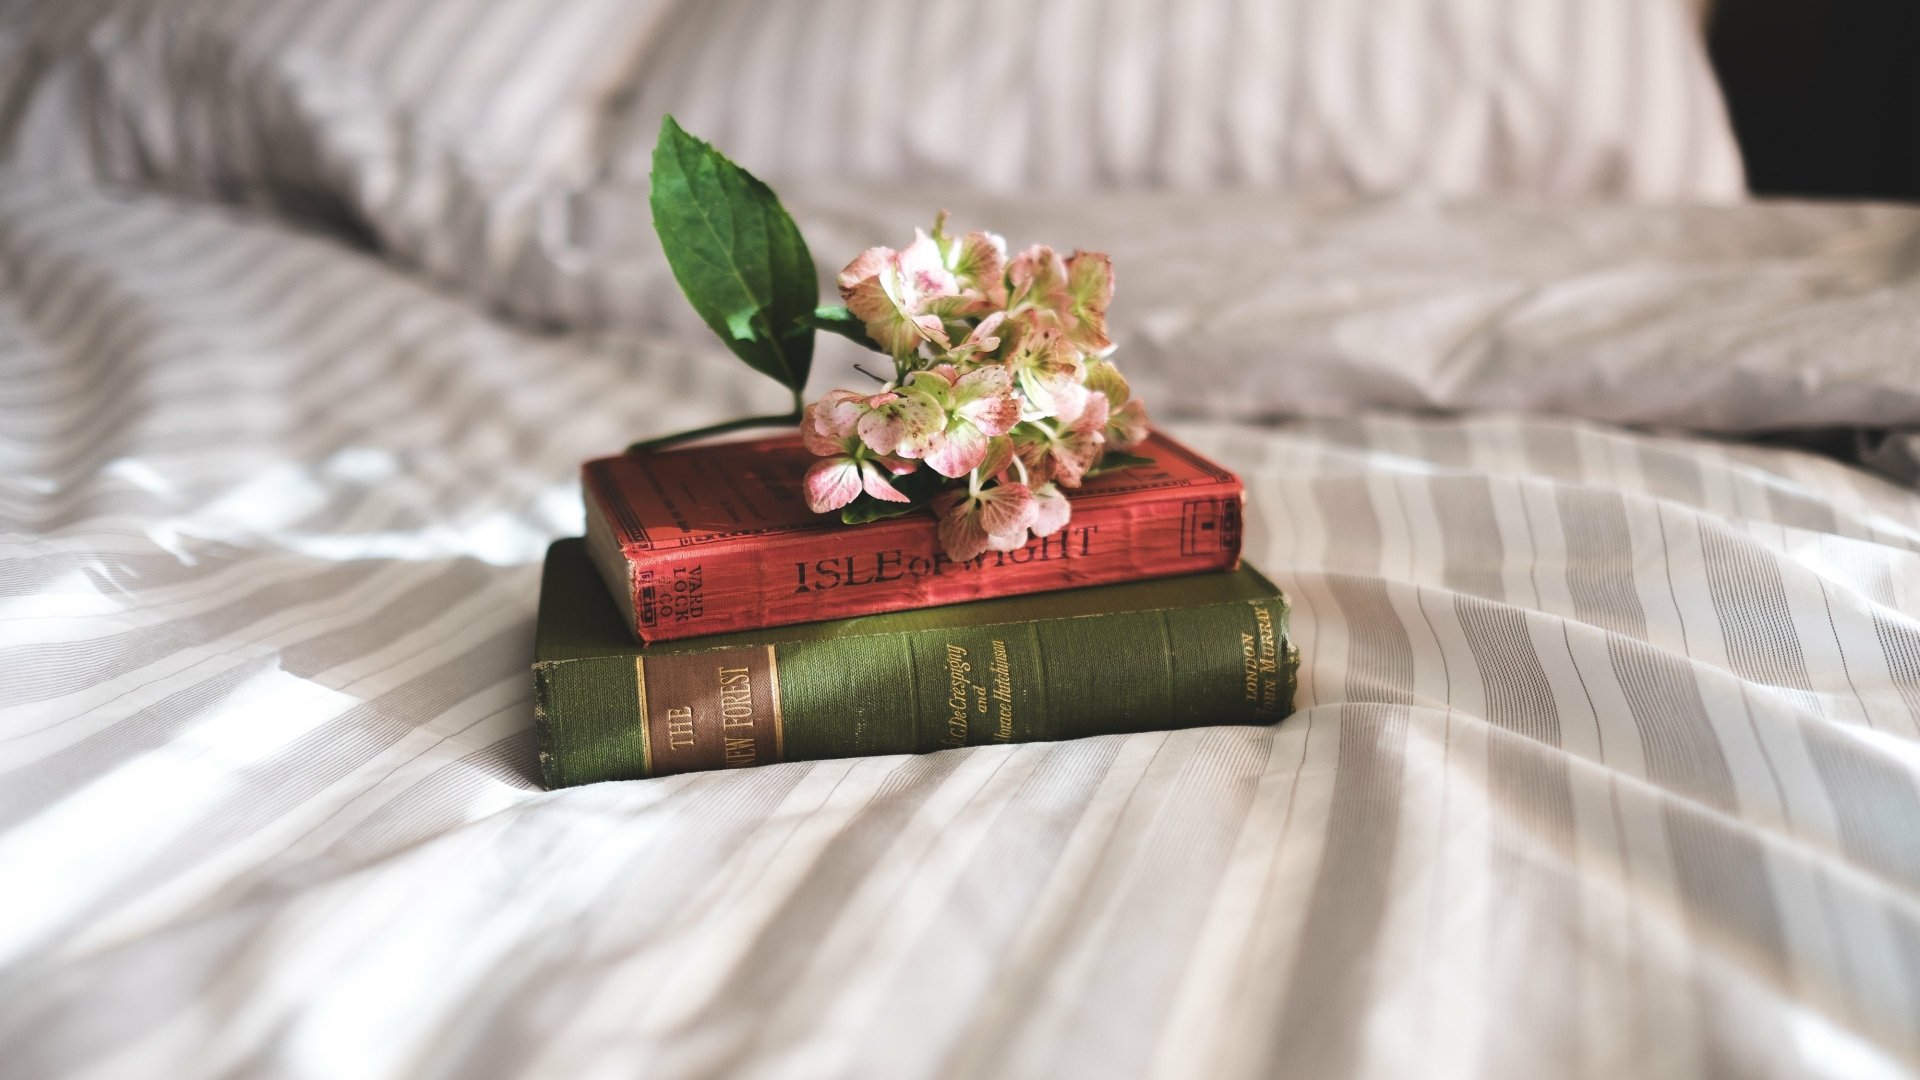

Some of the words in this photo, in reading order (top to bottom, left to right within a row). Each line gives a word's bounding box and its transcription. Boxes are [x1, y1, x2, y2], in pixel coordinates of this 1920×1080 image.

[671, 567, 689, 622] LOCK
[689, 565, 703, 618] WARD
[795, 550, 904, 593] ISLE
[1242, 631, 1258, 701] LONDON
[1255, 607, 1276, 673] MURRAY
[719, 667, 753, 730] FOREST
[947, 643, 971, 710] Crespigny
[973, 685, 987, 713] and
[990, 639, 1011, 702] Hutchinson
[667, 706, 694, 750] THE
